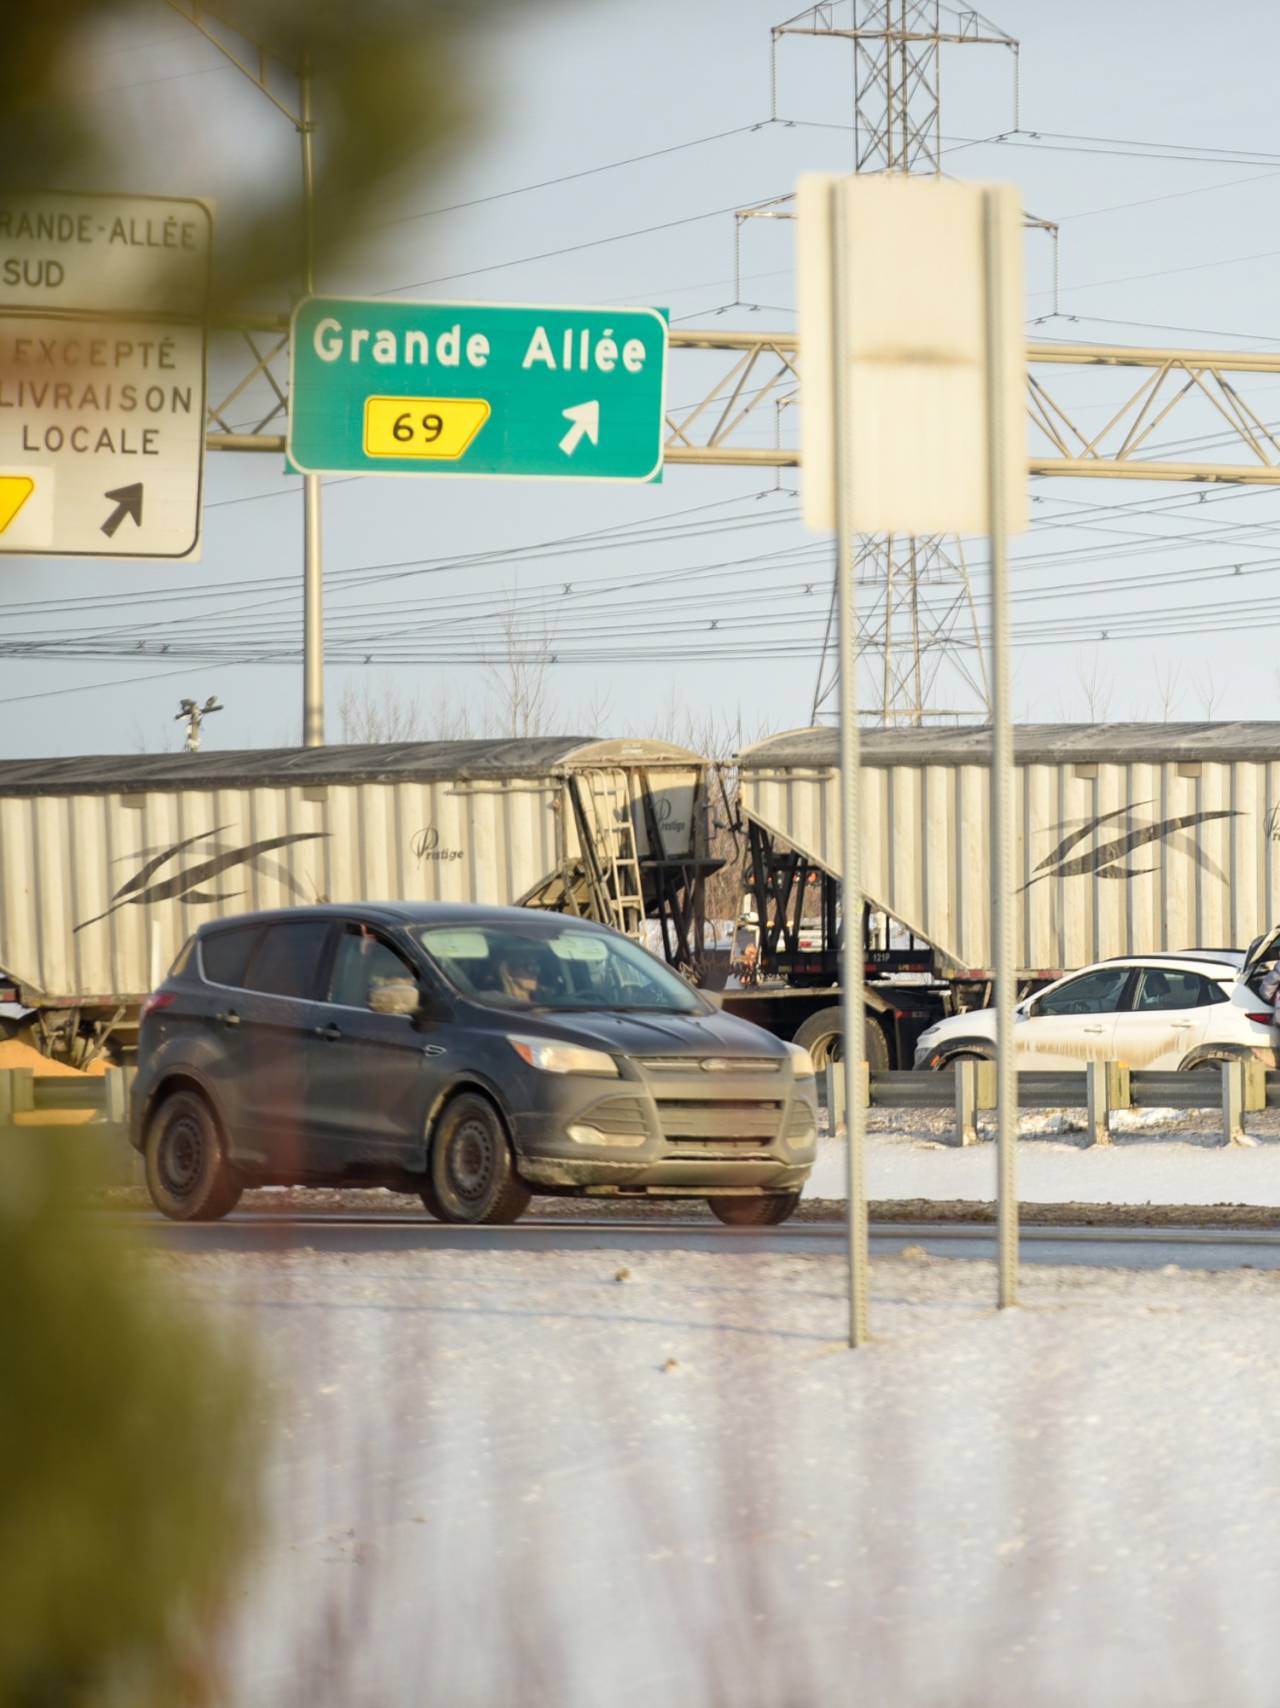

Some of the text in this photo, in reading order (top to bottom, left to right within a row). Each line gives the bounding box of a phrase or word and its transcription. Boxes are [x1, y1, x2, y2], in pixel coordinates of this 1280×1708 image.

[2, 258, 65, 288] SUD
[12, 336, 176, 370] EXCEPTÉ
[312, 317, 647, 373] Grande Allée
[0, 379, 192, 414] LIVRAISON
[22, 424, 160, 455] LOCALE
[391, 412, 443, 443] 69
